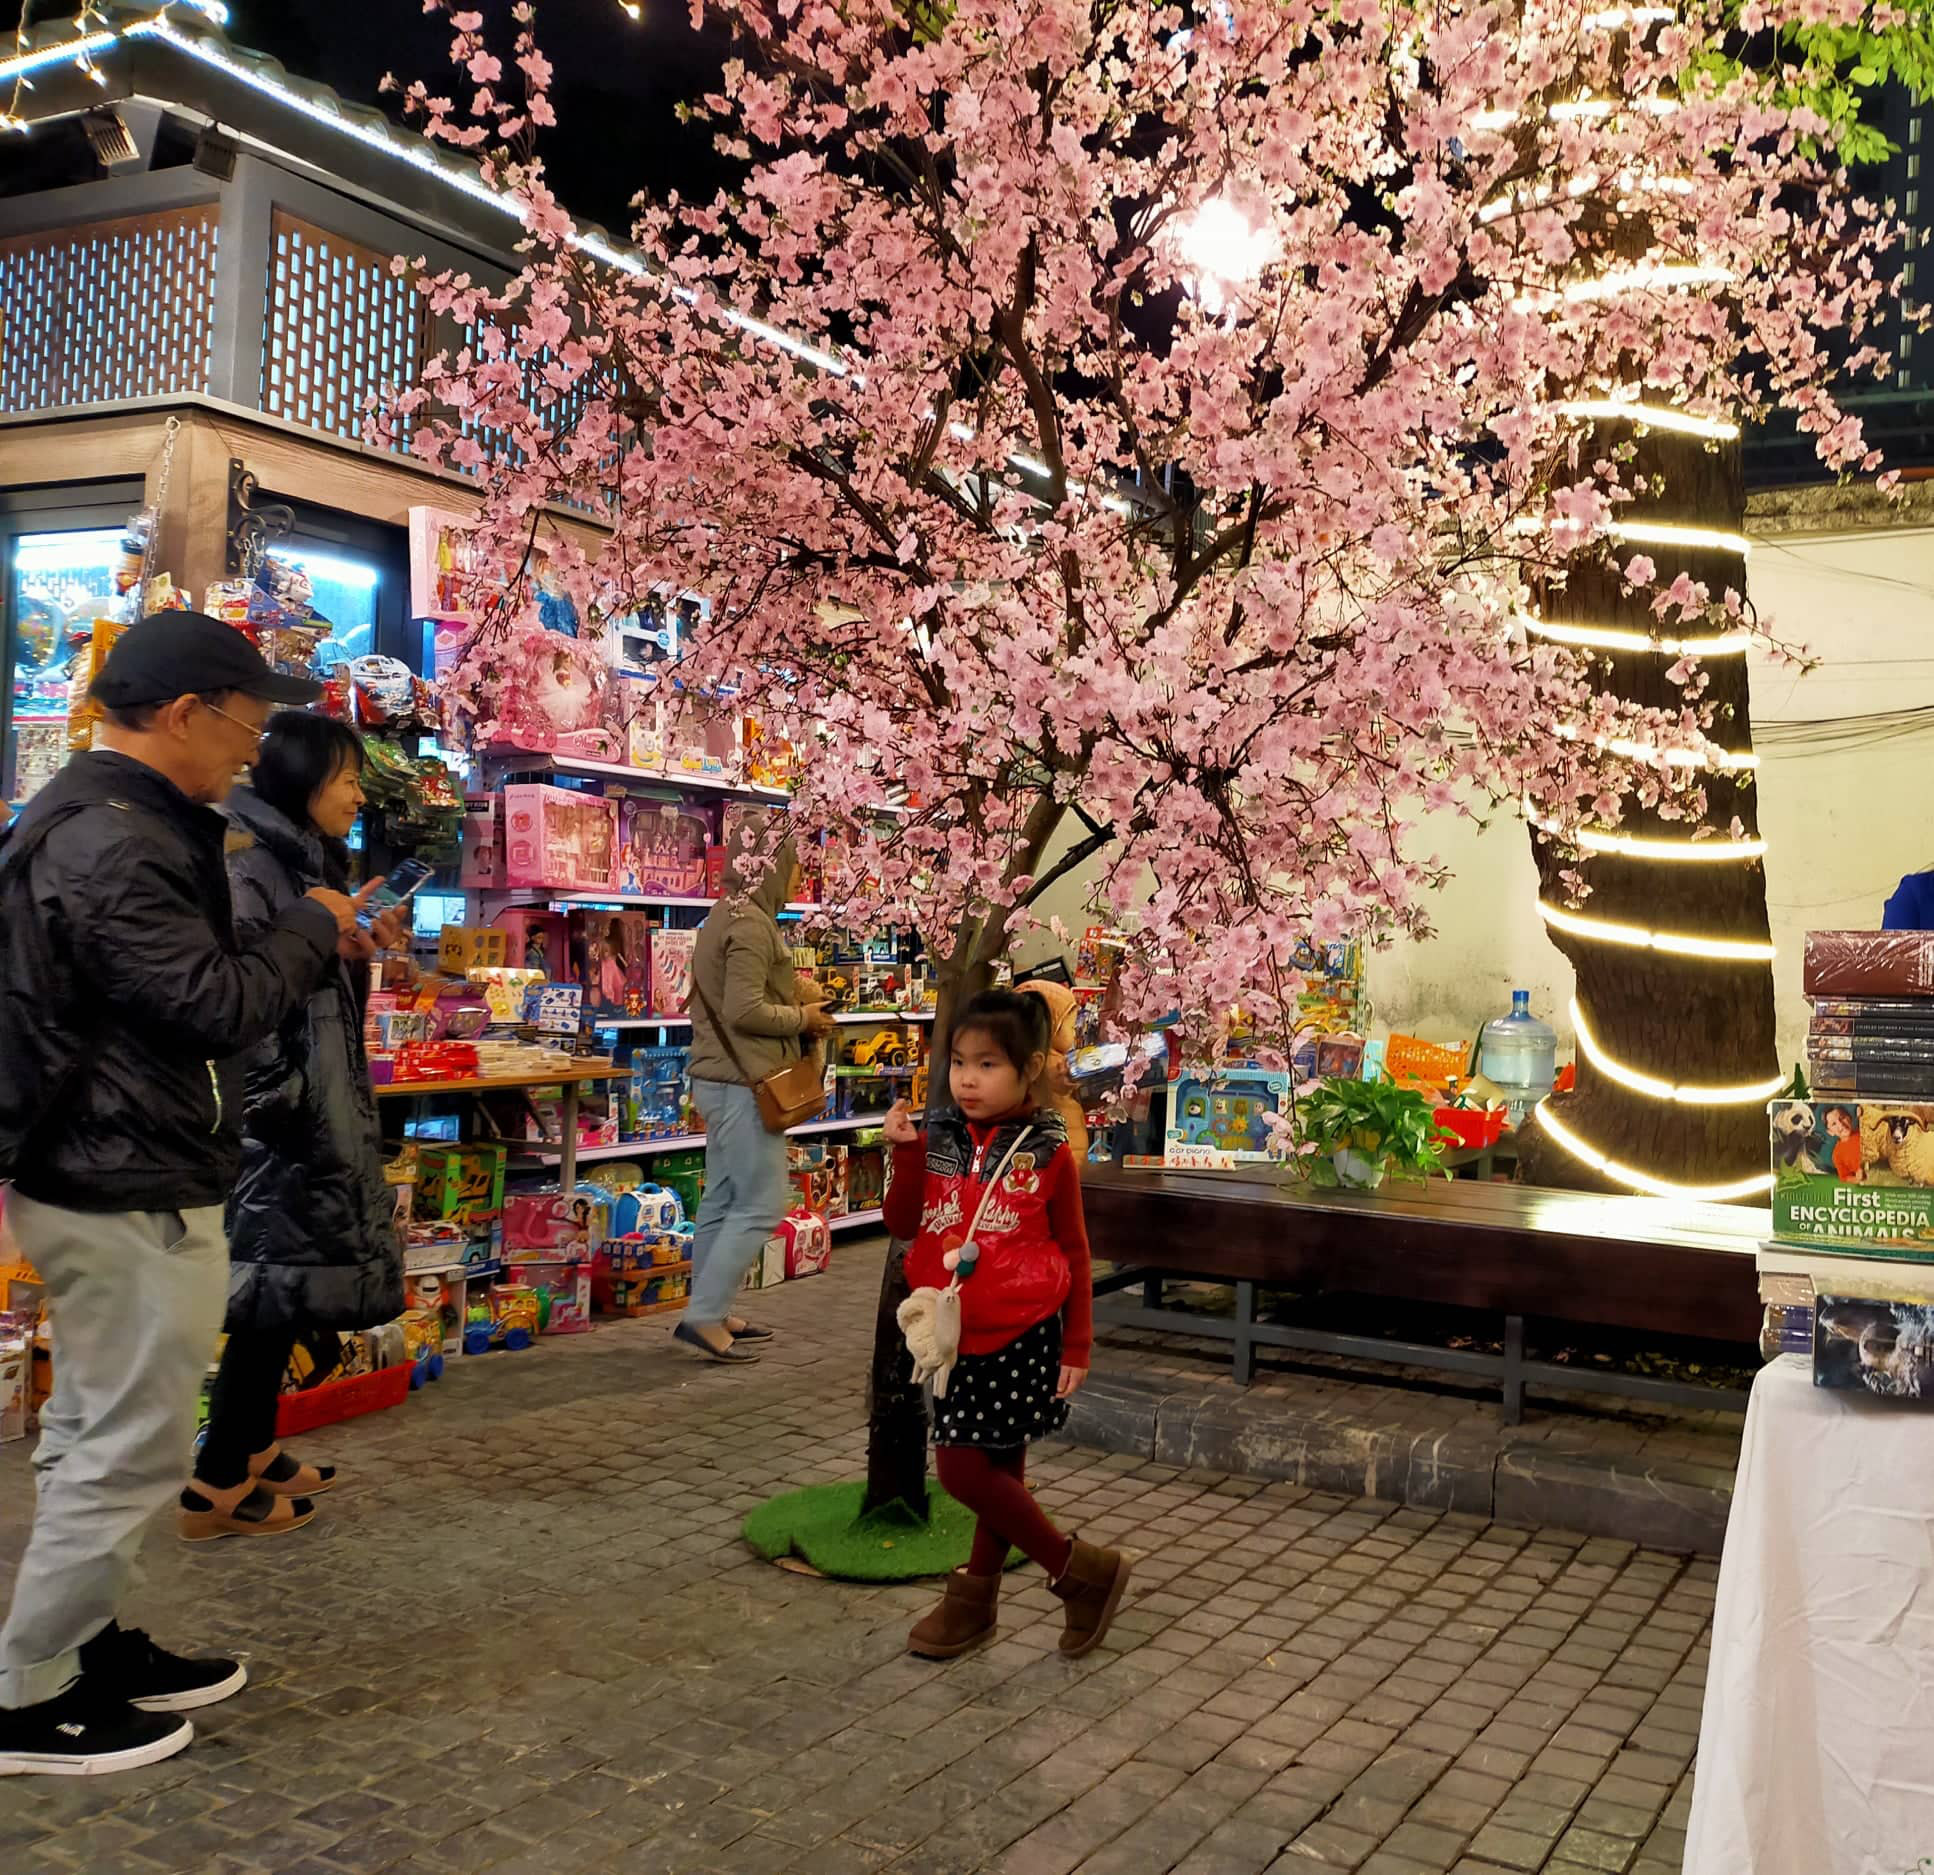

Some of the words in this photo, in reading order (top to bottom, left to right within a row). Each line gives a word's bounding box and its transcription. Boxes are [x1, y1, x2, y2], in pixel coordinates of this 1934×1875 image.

[1833, 1187, 1881, 1208] First
[1790, 1205, 1930, 1227] ENCYCLOPEDIA
[1812, 1223, 1915, 1240] ANIMALS
